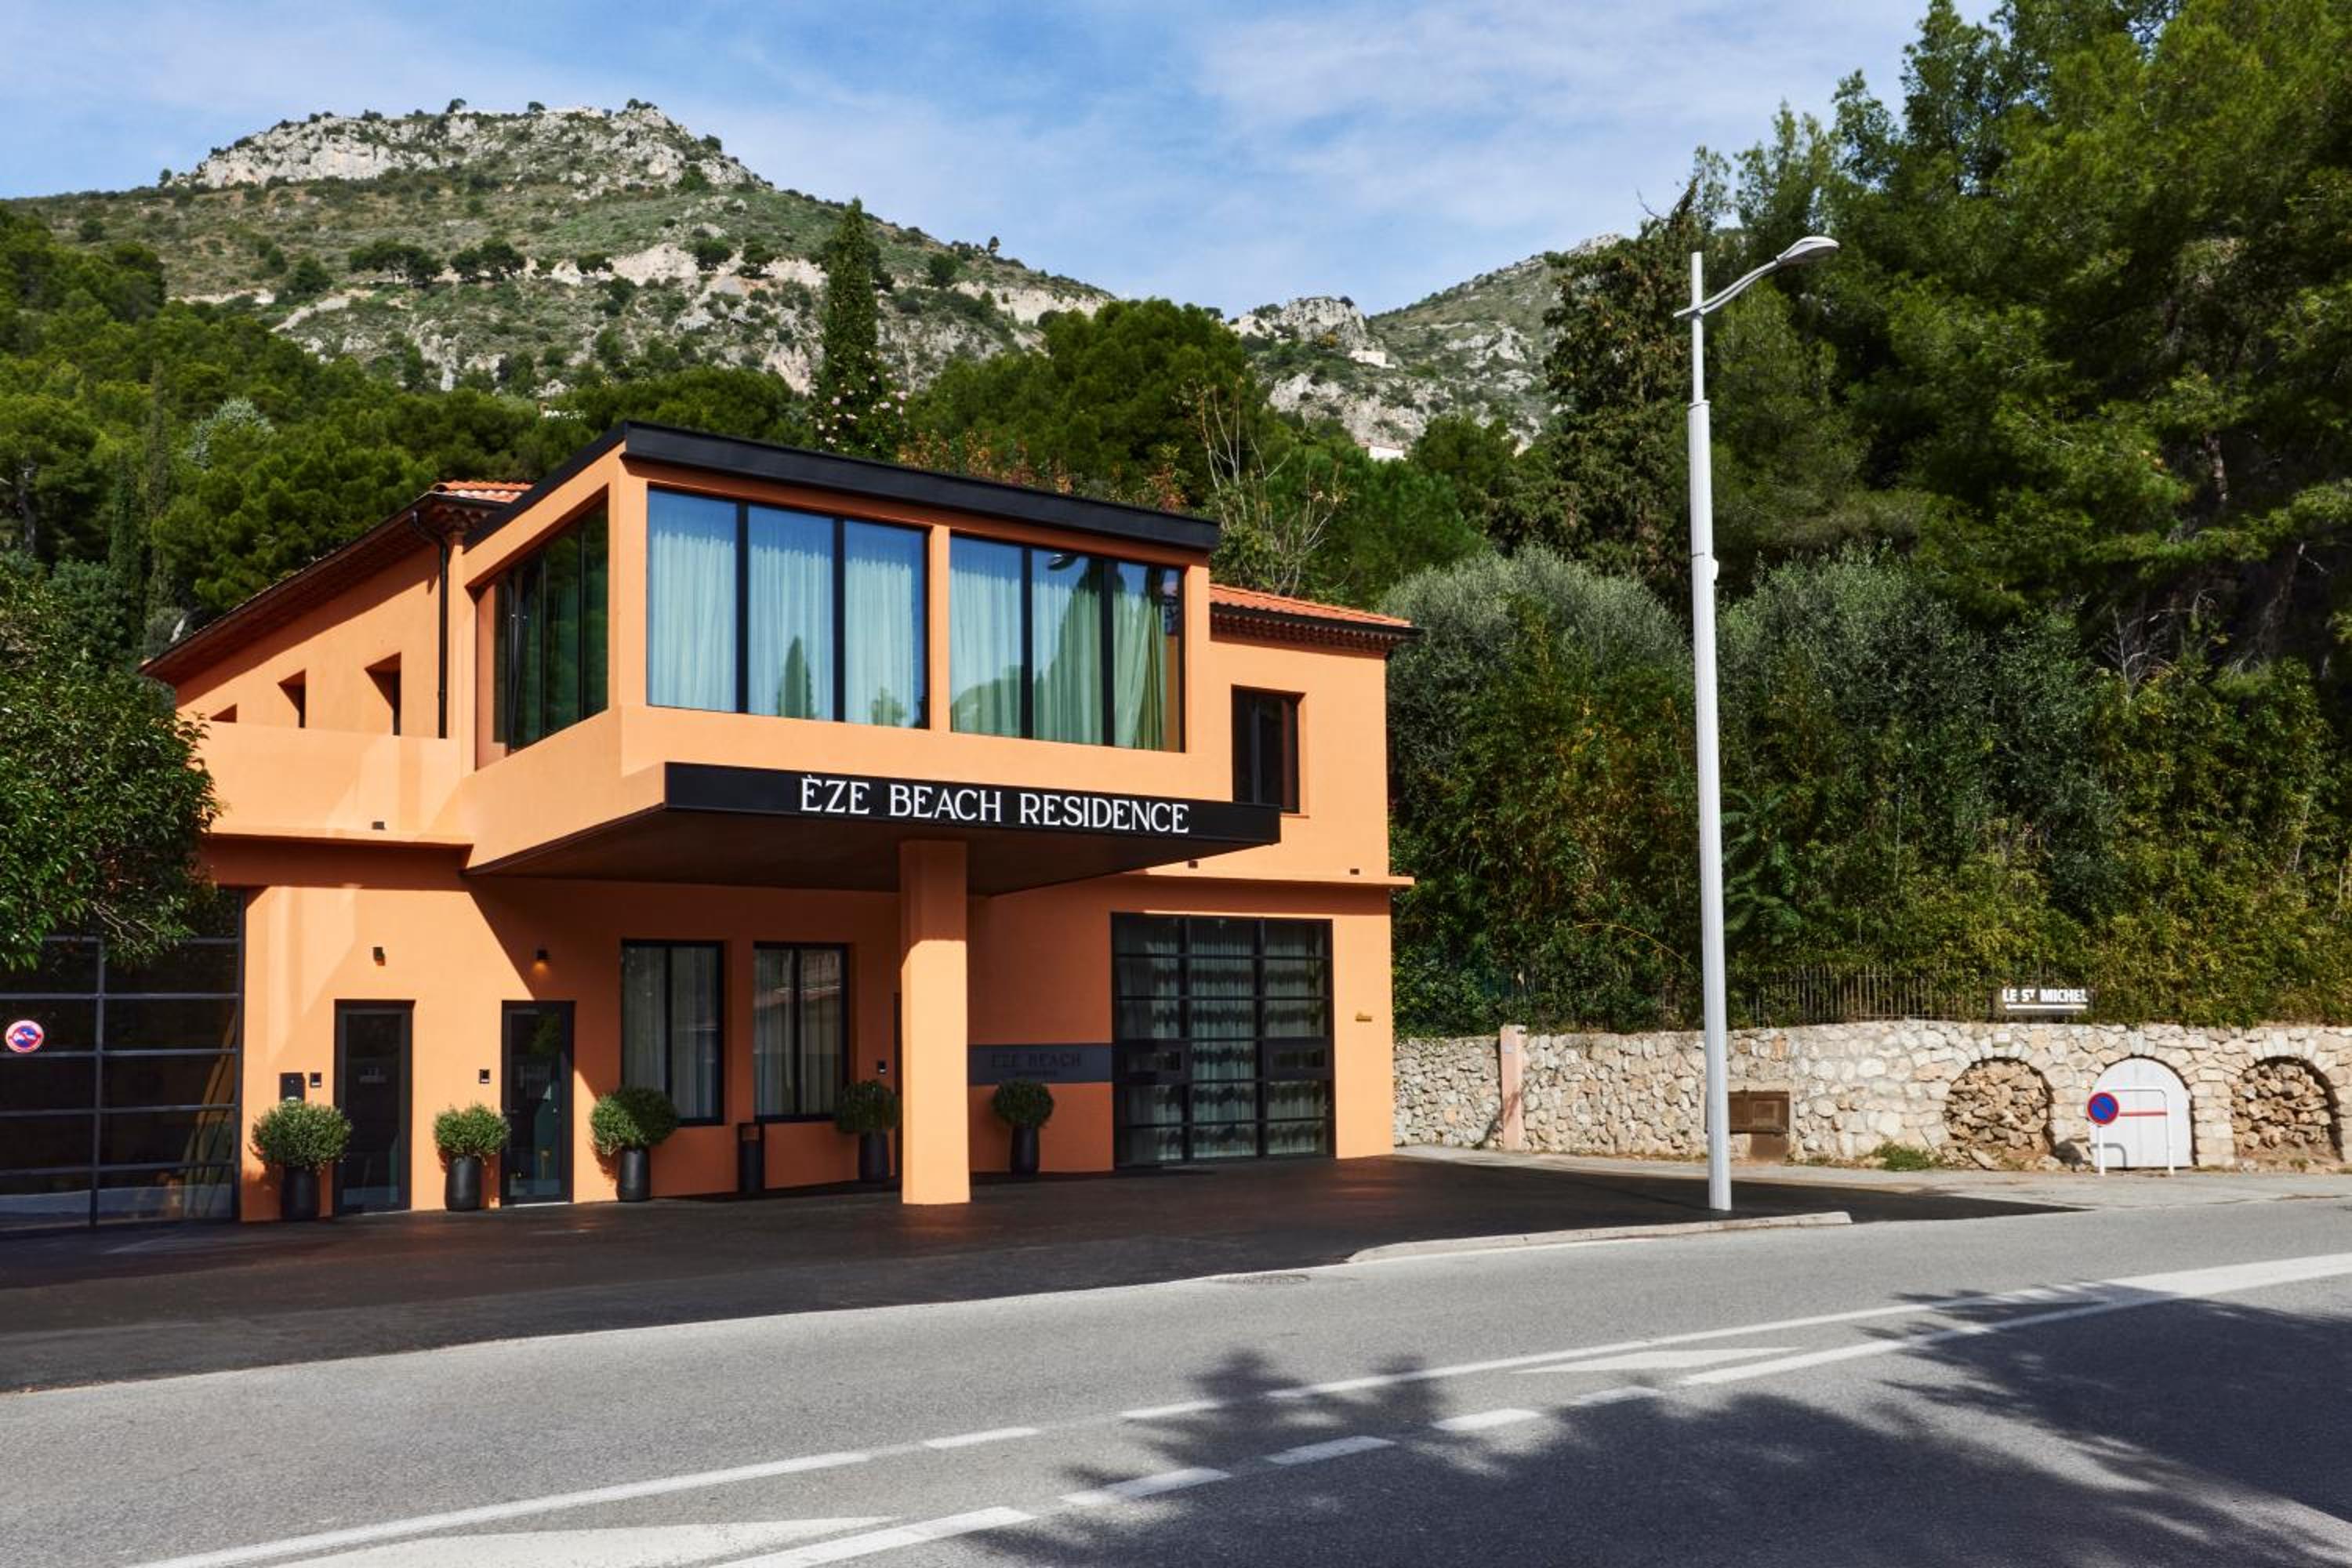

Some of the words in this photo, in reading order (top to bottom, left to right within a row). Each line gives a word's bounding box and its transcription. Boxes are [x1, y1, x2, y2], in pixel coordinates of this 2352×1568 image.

[800, 775, 870, 815] ÈZE
[889, 784, 1002, 822] BEACH
[1020, 792, 1190, 834] RESIDENCE
[2002, 989, 2017, 1002] LE
[2040, 989, 2089, 1003] MICHEL
[1029, 1053, 1081, 1067] BEACH
